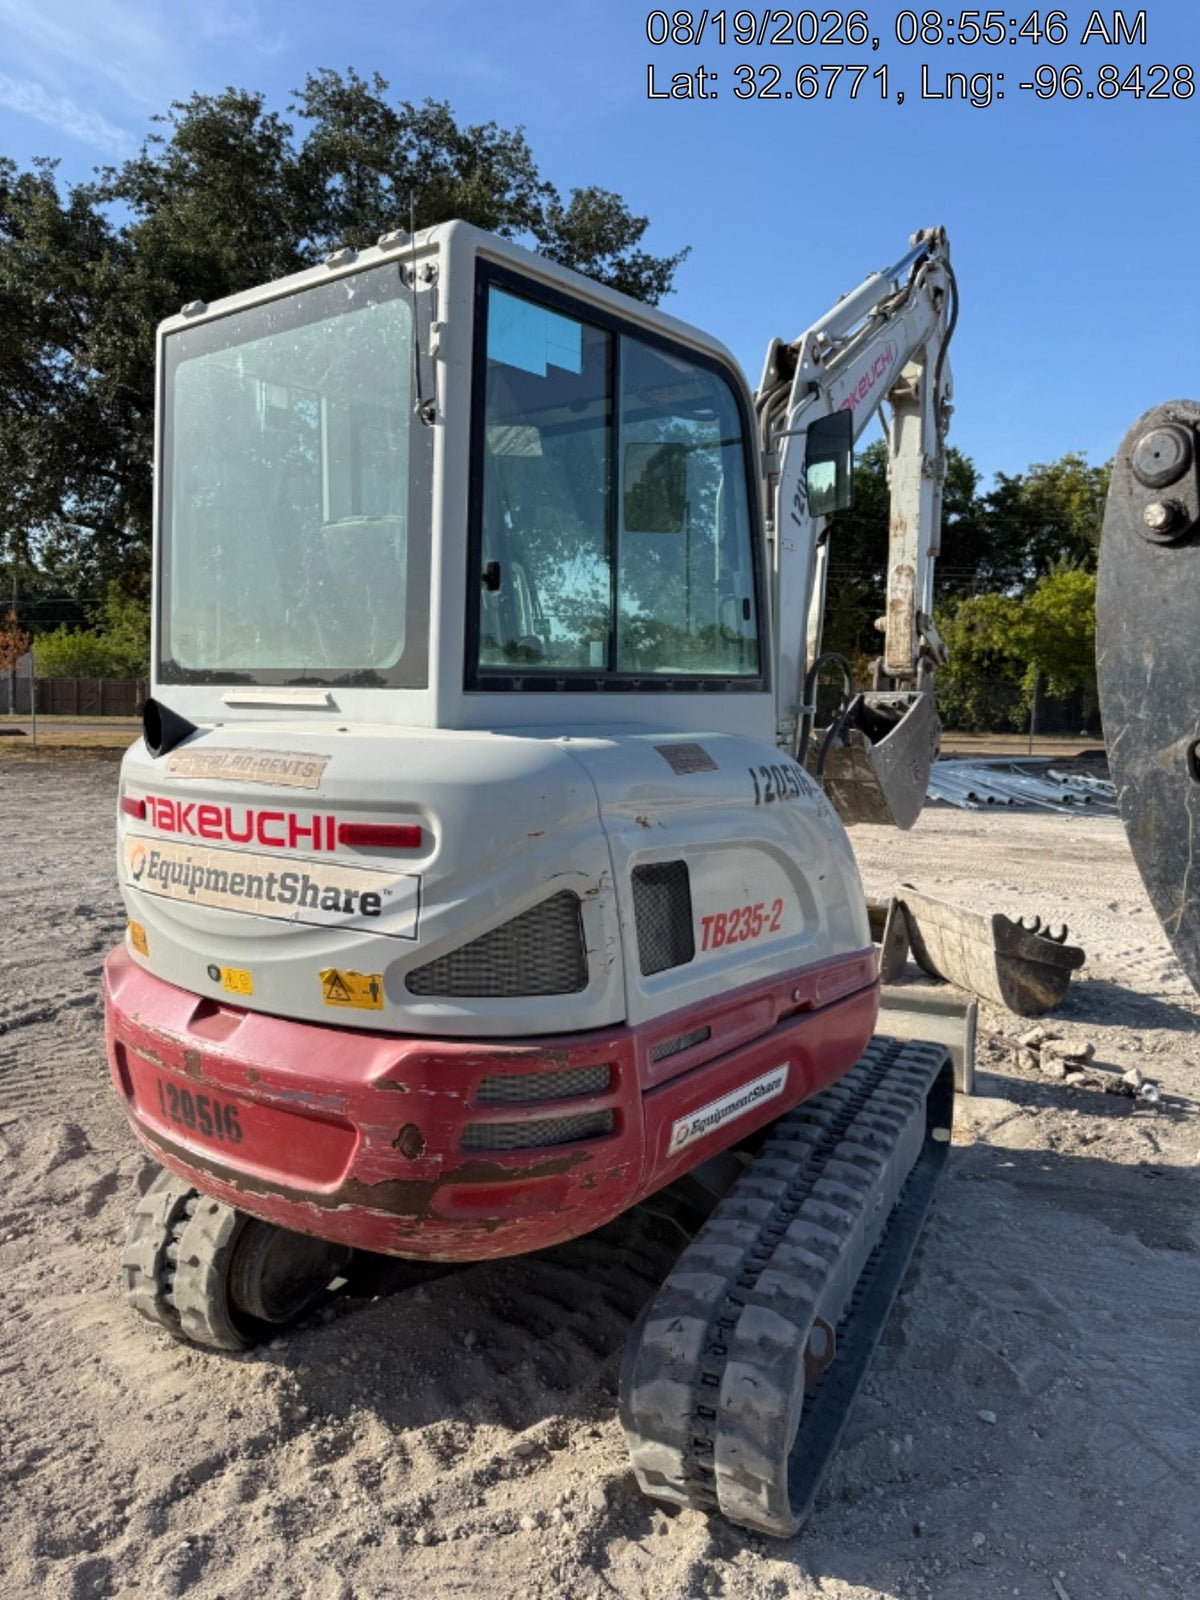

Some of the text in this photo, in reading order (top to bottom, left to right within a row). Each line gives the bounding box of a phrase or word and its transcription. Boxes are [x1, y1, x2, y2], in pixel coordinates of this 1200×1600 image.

[837, 344, 893, 411] AKEUCHI
[146, 851, 382, 917] EquipmentShare
[701, 898, 784, 952] TB235-2
[156, 1077, 244, 1145] 120516
[689, 1077, 782, 1137] EquipmentShare
